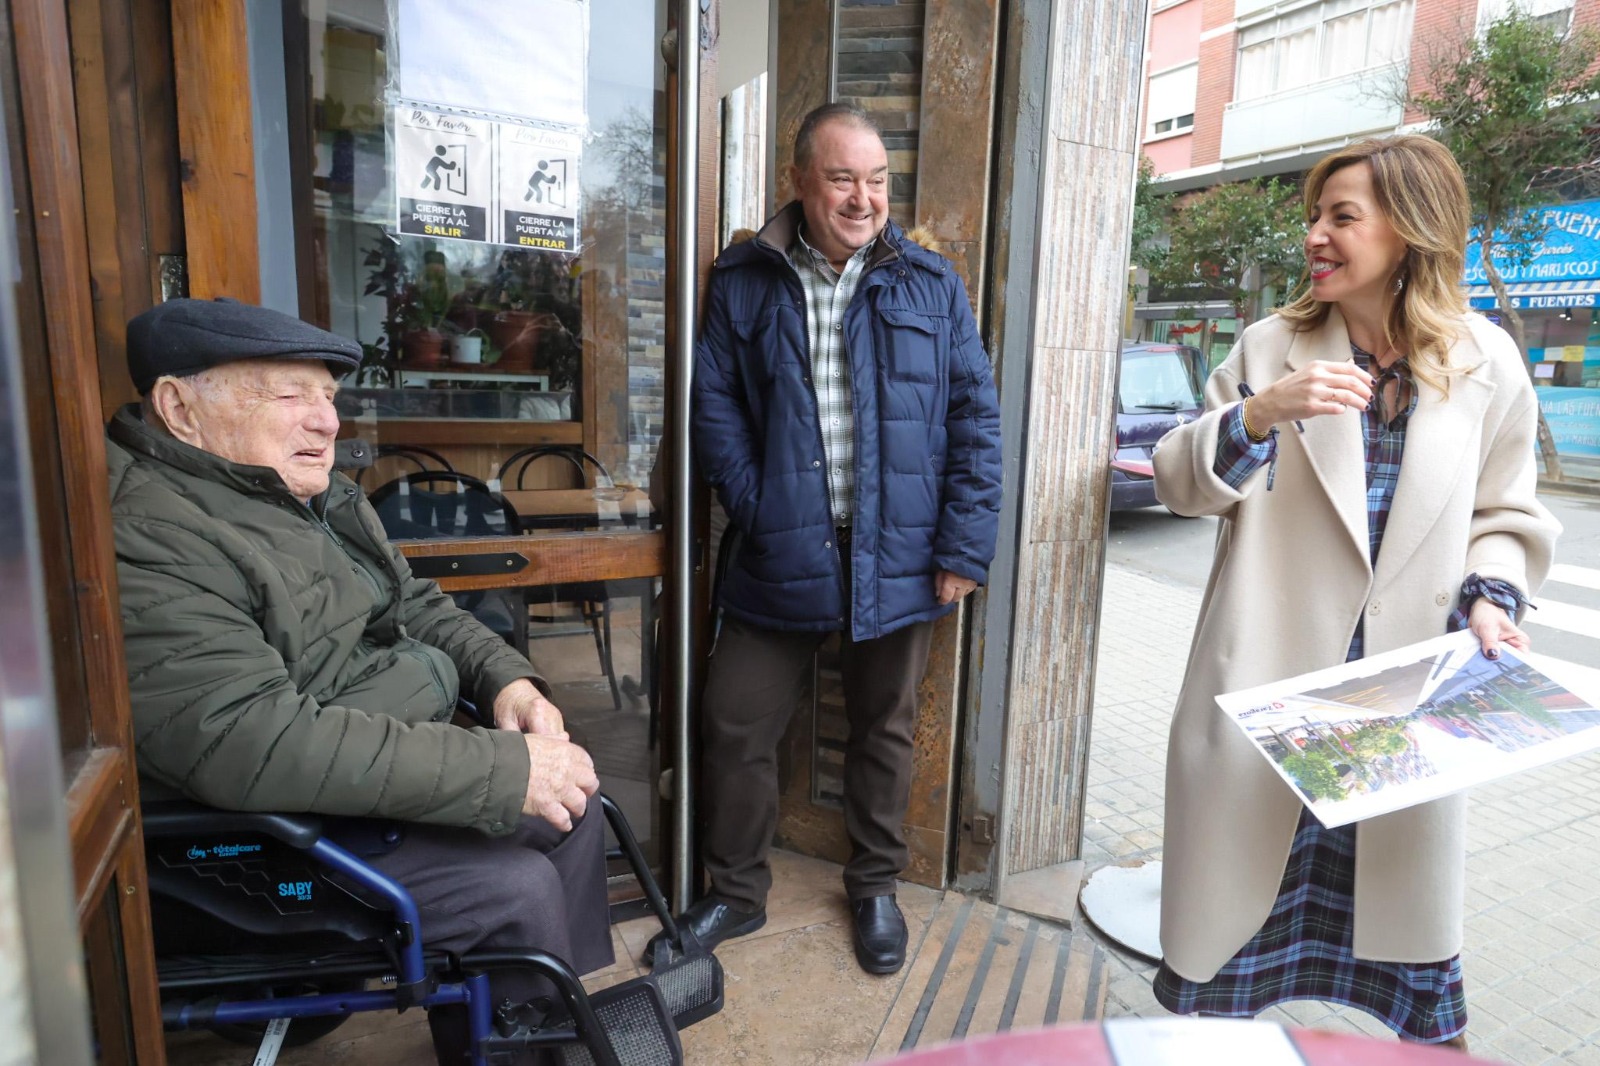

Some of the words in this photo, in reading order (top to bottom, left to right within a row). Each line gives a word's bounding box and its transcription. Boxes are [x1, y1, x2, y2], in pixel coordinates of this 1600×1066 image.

[412, 110, 431, 126] Por
[437, 115, 471, 131] Favor
[416, 203, 451, 215] CIERRE
[453, 208, 467, 217] LA
[412, 213, 454, 225] PUERTA
[456, 219, 470, 227] AL
[519, 216, 551, 227] CIERRE
[552, 220, 566, 228] LA
[424, 224, 462, 238] SALIR
[516, 225, 554, 237] PUERTA
[555, 230, 568, 238] AL
[519, 236, 566, 249] ENTRAR
[1464, 262, 1518, 281] ESCOS
[1529, 261, 1598, 278] MARISCOS
[1494, 297, 1520, 309] LS
[1529, 294, 1595, 308] FUENTES
[278, 881, 313, 897] SABY
